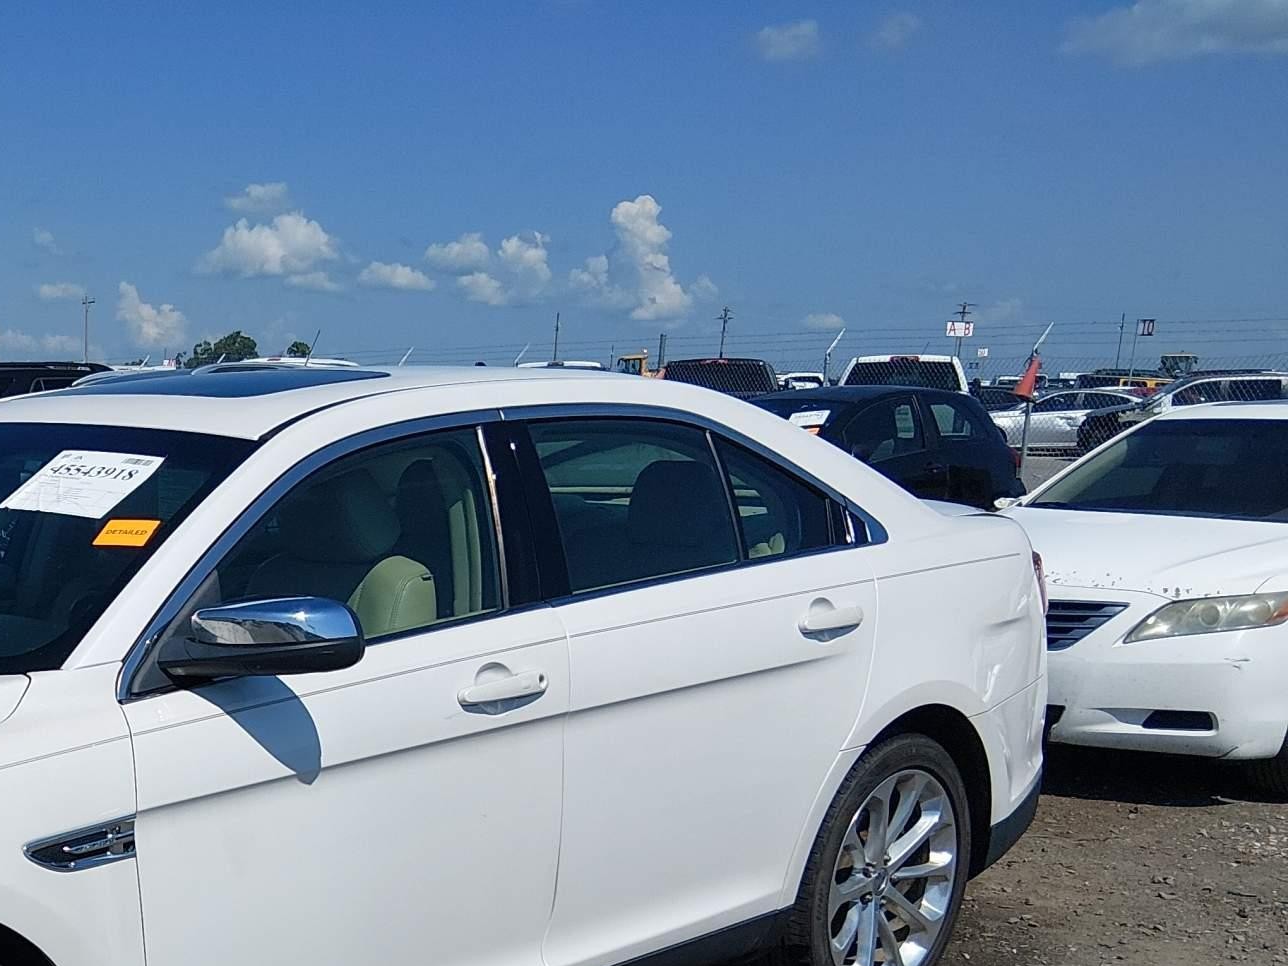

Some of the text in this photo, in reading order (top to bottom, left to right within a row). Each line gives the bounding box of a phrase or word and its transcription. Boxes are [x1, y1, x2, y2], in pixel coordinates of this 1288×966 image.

[948, 321, 971, 336] A B
[50, 464, 139, 480] 45543918
